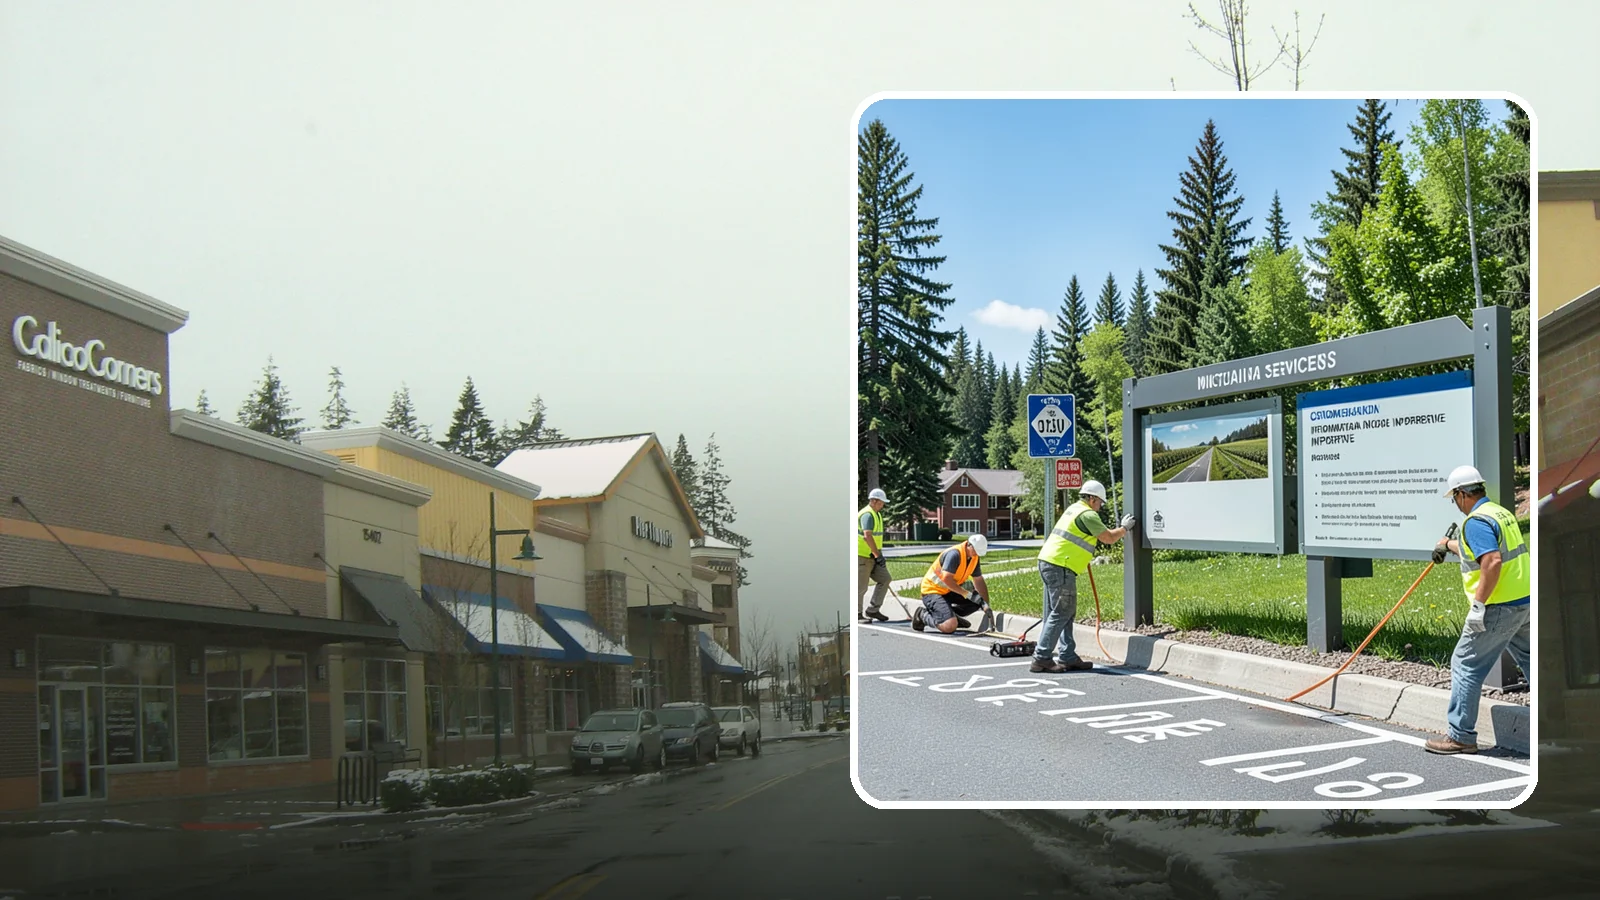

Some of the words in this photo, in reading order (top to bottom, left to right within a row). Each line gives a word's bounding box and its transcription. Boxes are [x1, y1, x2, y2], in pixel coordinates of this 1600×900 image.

[16, 360, 47, 378] FABRICS
[51, 370, 78, 387] WINDOW
[78, 379, 116, 399] TREATMENTS
